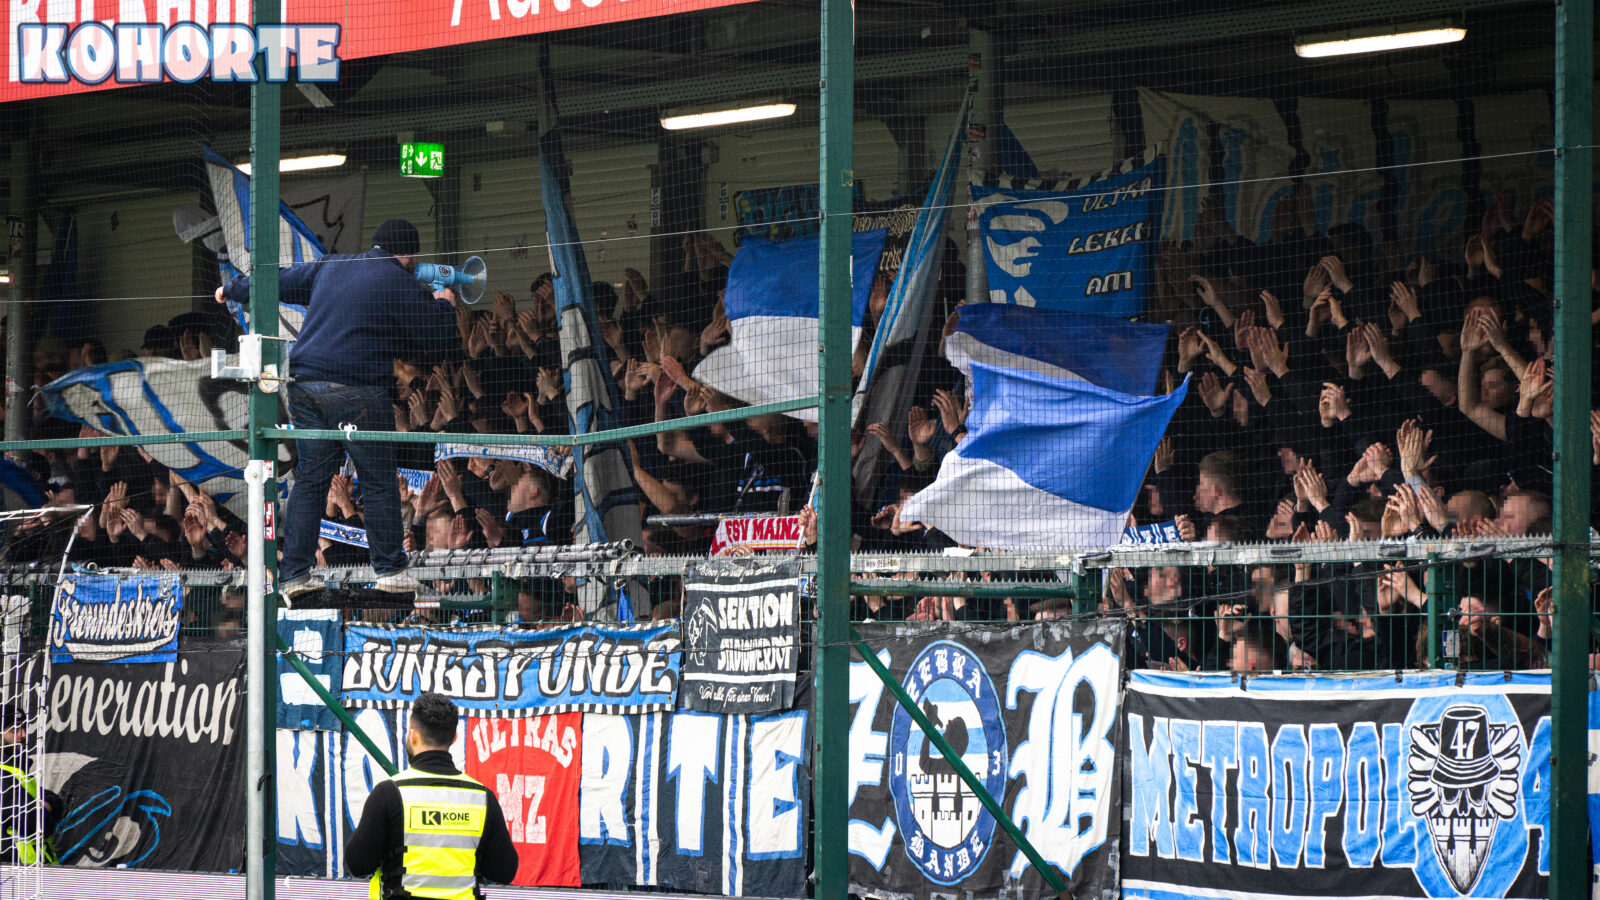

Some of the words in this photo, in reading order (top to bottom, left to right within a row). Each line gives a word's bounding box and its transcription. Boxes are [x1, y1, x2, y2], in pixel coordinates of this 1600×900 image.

[1067, 221, 1151, 255] LEBEN
[1085, 271, 1132, 296] AM
[725, 518, 750, 543] FSV
[753, 517, 801, 540] MAINZ
[718, 592, 793, 630] SEKTION
[342, 635, 682, 699] JUNGSPUNDE
[472, 713, 577, 769] ULTRAS
[1449, 720, 1480, 760] 47
[442, 812, 470, 821] KONE
[496, 774, 547, 844] MZ
[909, 831, 984, 878] BANDE
